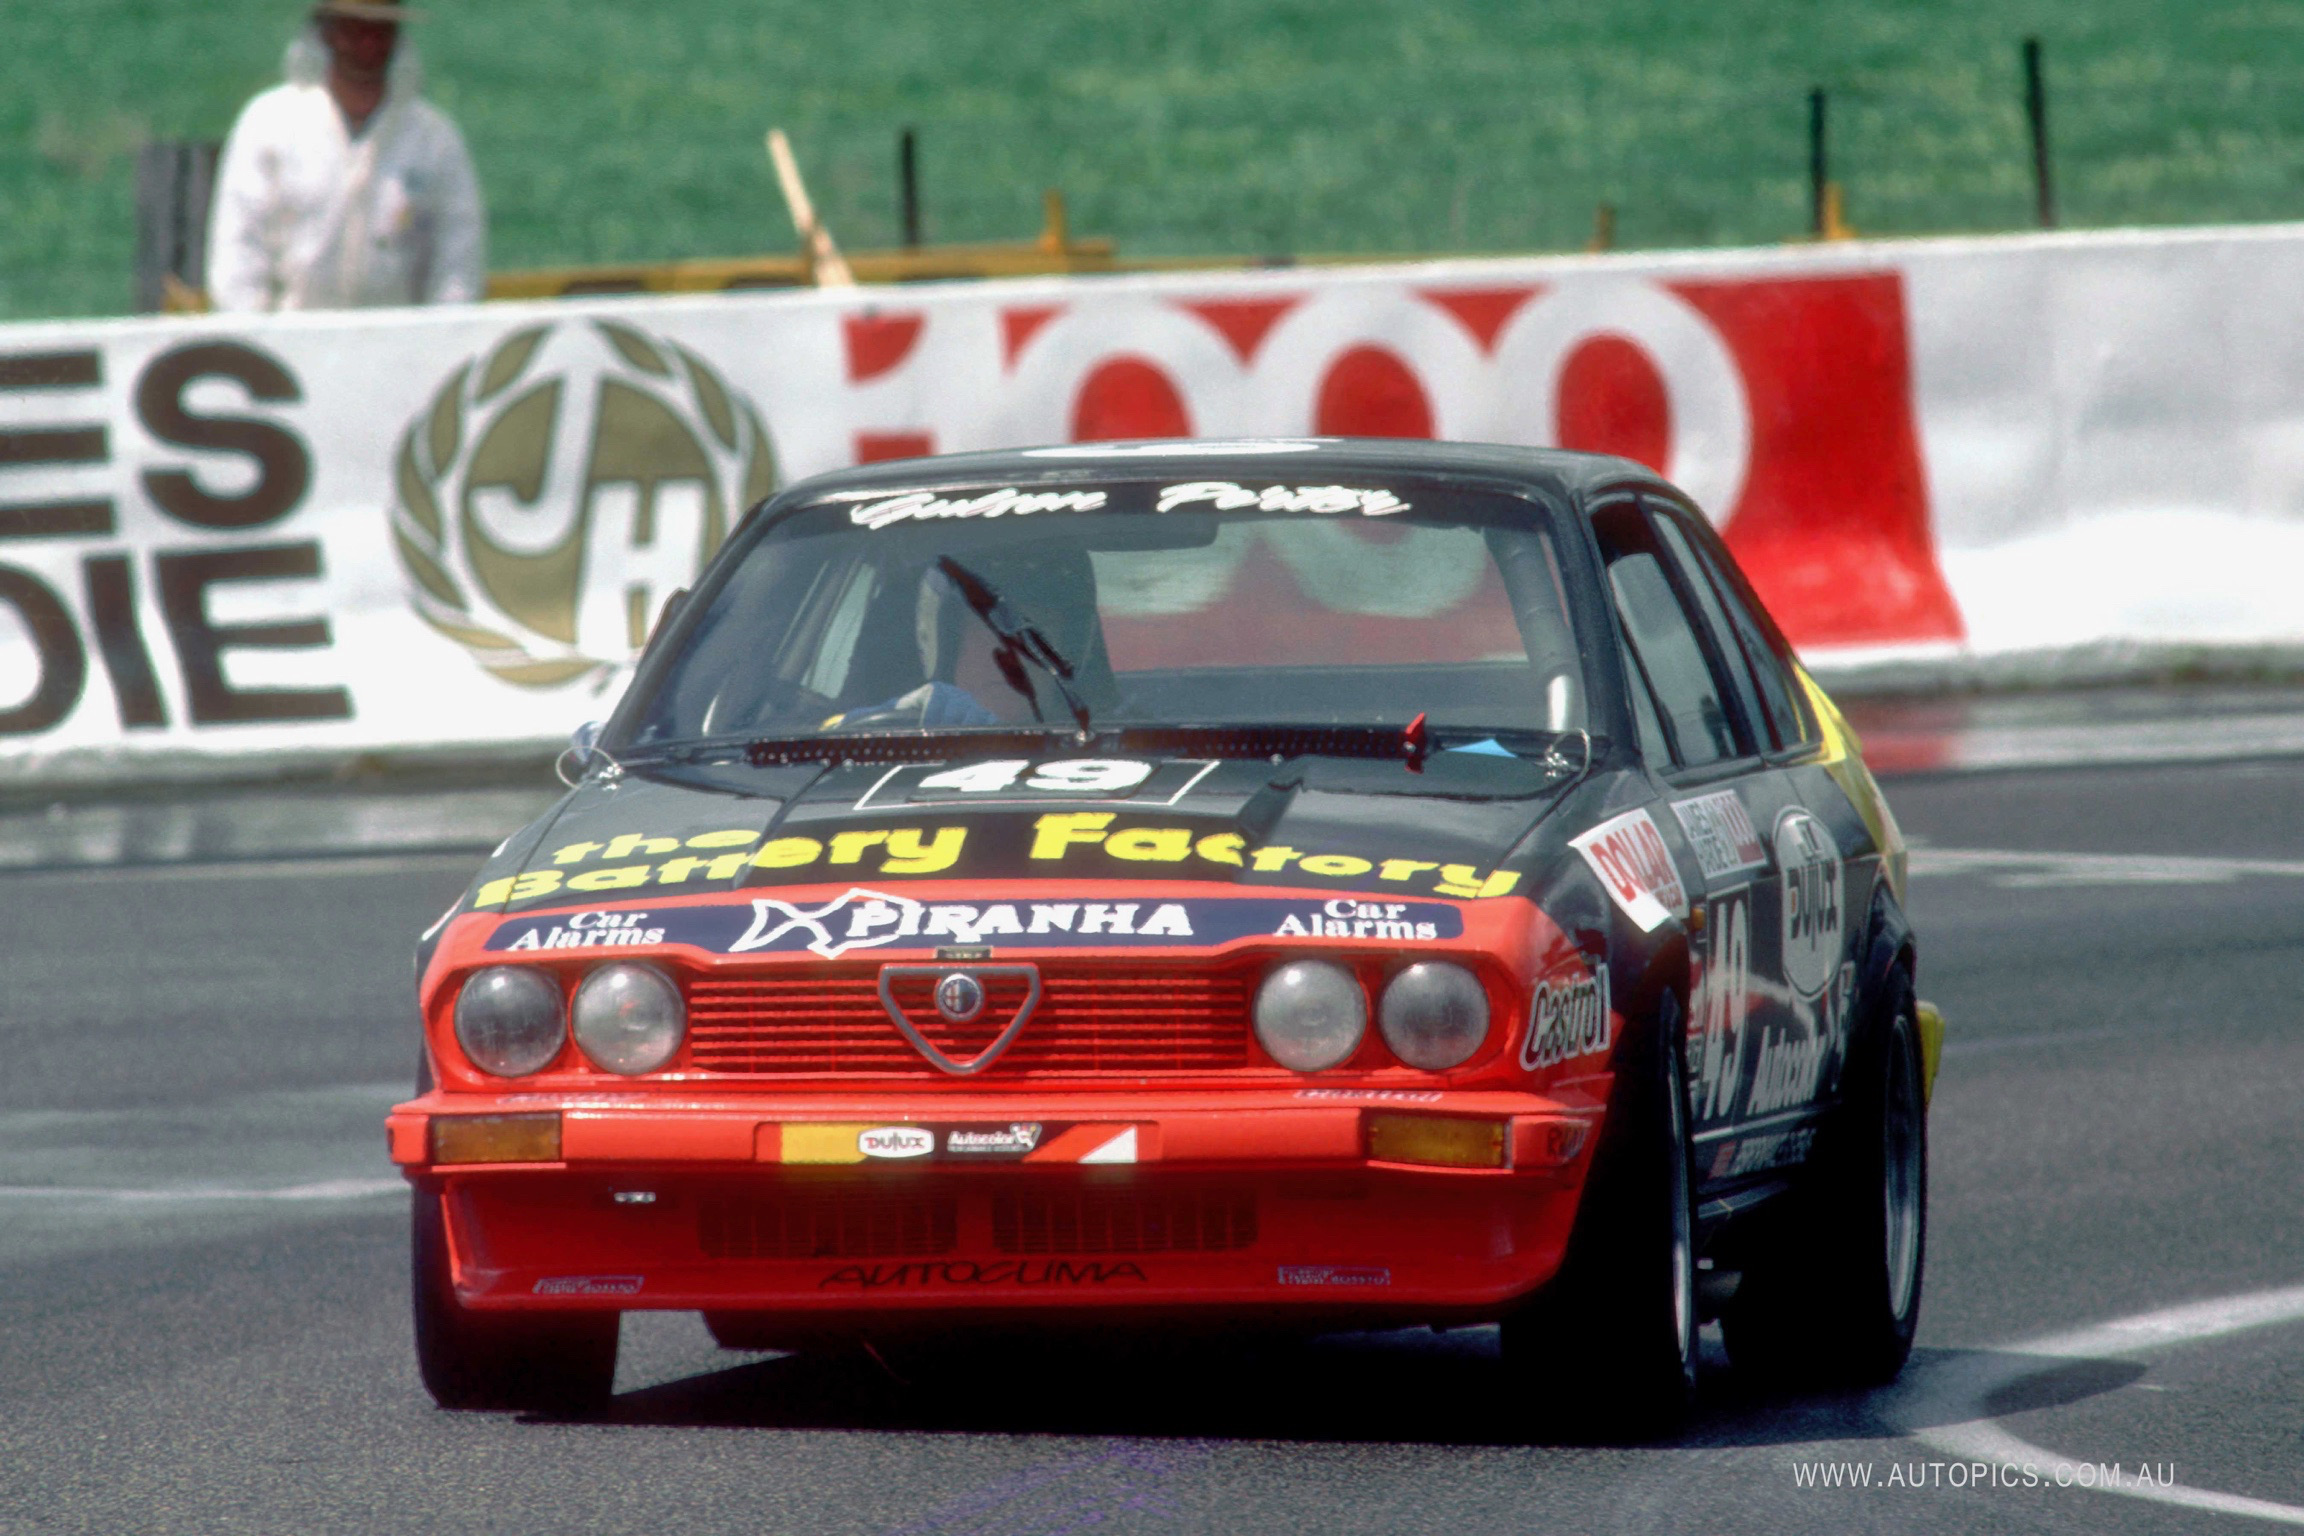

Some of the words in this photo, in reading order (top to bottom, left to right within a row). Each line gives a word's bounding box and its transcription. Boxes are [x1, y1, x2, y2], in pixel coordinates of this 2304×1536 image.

[918, 759, 1151, 792] 49
[474, 827, 968, 908] Battery
[1029, 812, 1521, 899] Factory
[552, 829, 760, 865] the
[569, 911, 649, 930] Car
[845, 902, 1194, 943] PIRANHA
[1323, 898, 1408, 921] Car
[506, 926, 666, 953] Alarms
[1272, 914, 1438, 940] Alarms
[1519, 962, 1612, 1071] Castrol
[864, 1132, 926, 1151] DULUX
